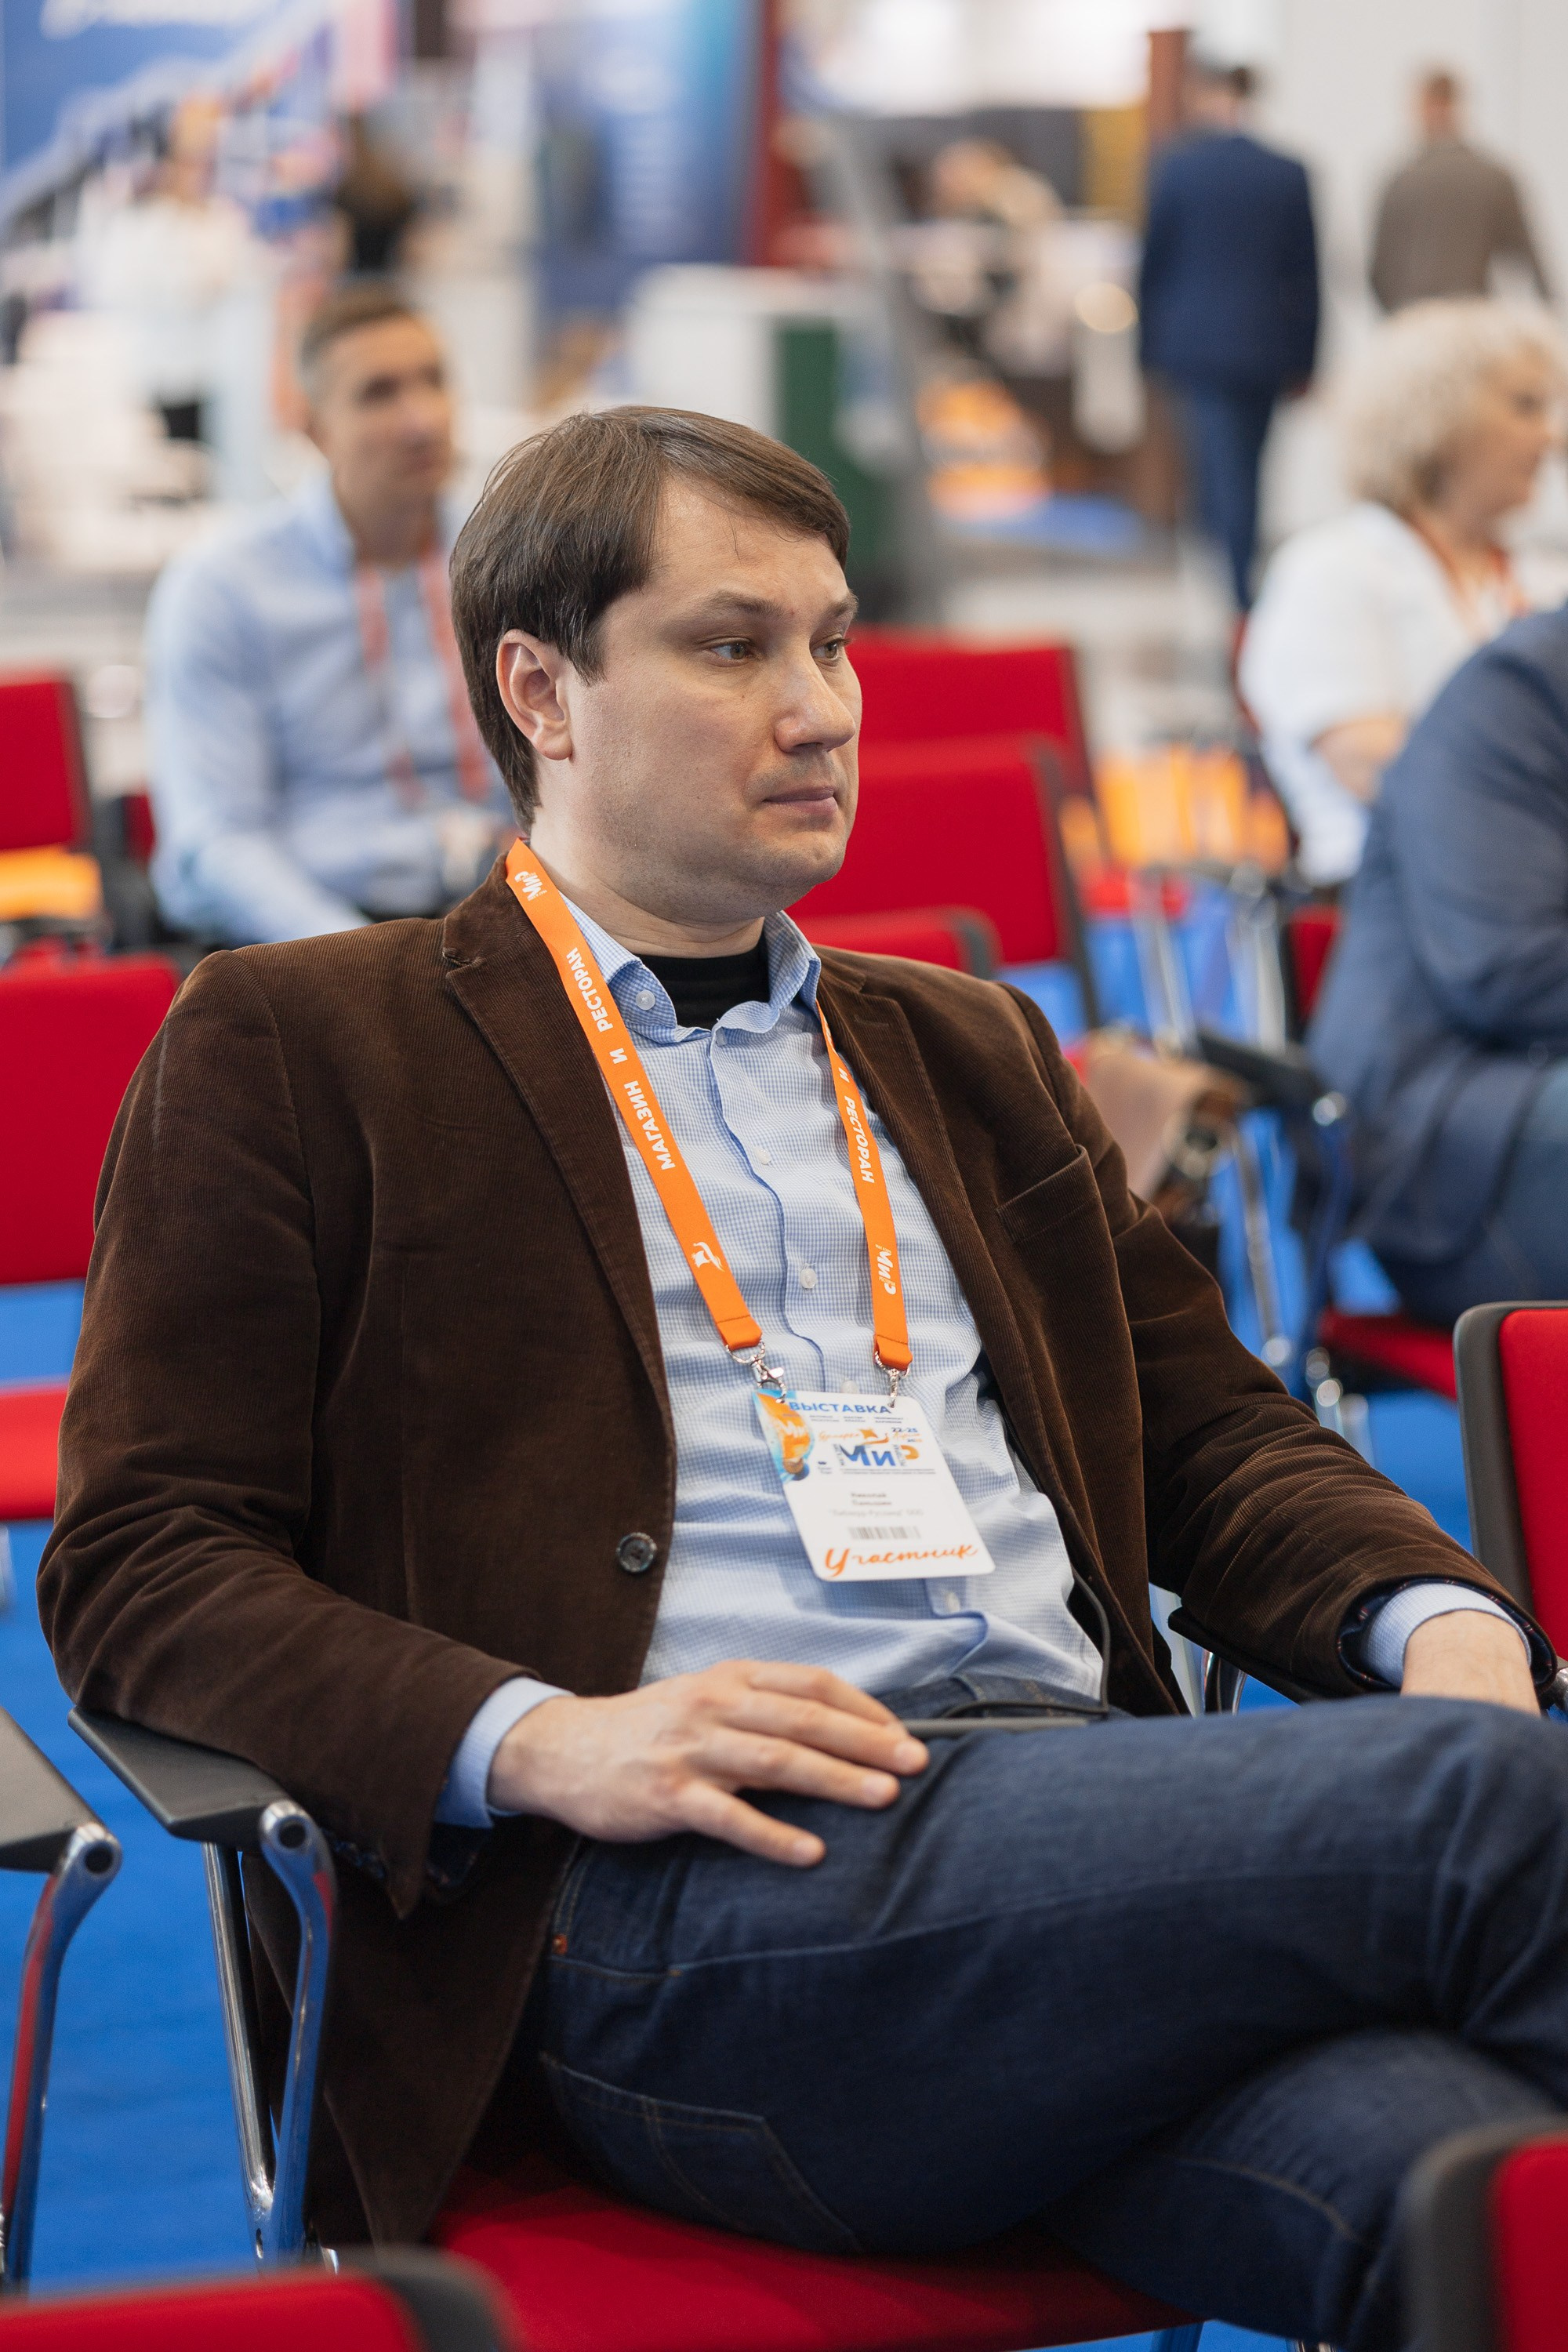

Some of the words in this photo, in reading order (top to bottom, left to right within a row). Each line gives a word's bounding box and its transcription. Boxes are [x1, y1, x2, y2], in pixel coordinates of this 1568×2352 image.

[566, 947, 614, 1033] РЕСТОРАН
[609, 1047, 628, 1065] И
[838, 1066, 851, 1083] И
[623, 1080, 676, 1171] МАГАЗИН
[844, 1095, 875, 1184] РЕСТОРАН
[789, 1401, 892, 1414] ВЫСТАВКА
[825, 1544, 978, 1578] Участник
